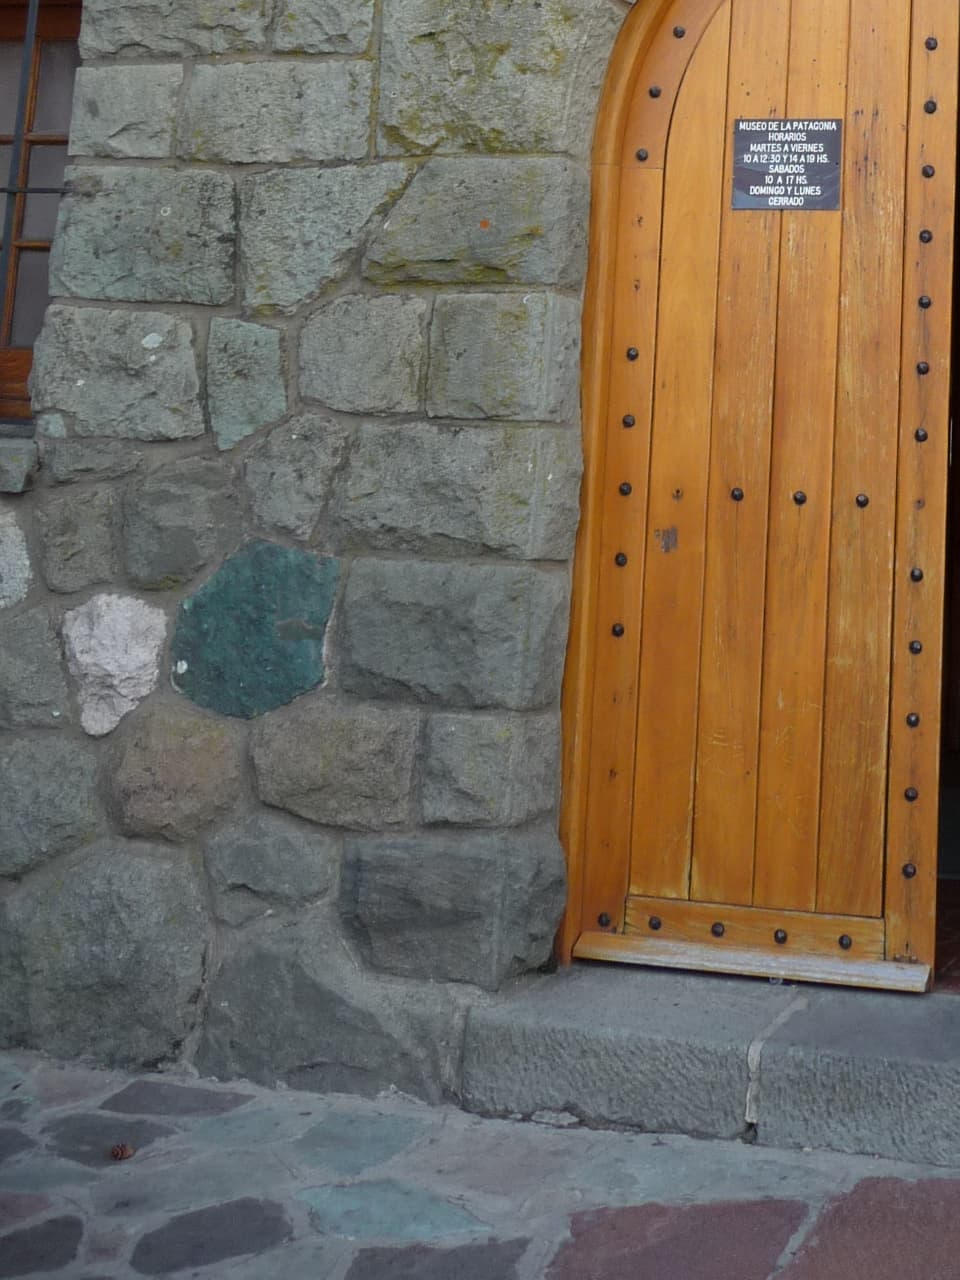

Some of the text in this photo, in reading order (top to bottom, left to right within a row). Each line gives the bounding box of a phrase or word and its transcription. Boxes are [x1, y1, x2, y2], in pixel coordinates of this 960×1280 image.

[739, 121, 837, 131] MUSEO DE LA PATAGONIA
[768, 132, 807, 142] HORARIOS
[750, 143, 825, 153] MARTES A VIERNES
[743, 153, 752, 163] 10
[753, 153, 759, 163] A
[782, 153, 788, 163] Y
[789, 153, 798, 163] 14
[799, 153, 806, 163] A
[806, 153, 816, 163] 19
[768, 164, 805, 174] SABADOS
[765, 175, 774, 184] 10
[776, 175, 783, 184] A
[785, 175, 795, 184] 17
[749, 185, 822, 195] DOMINGO Y LUNES
[768, 196, 804, 206] CERRADO
